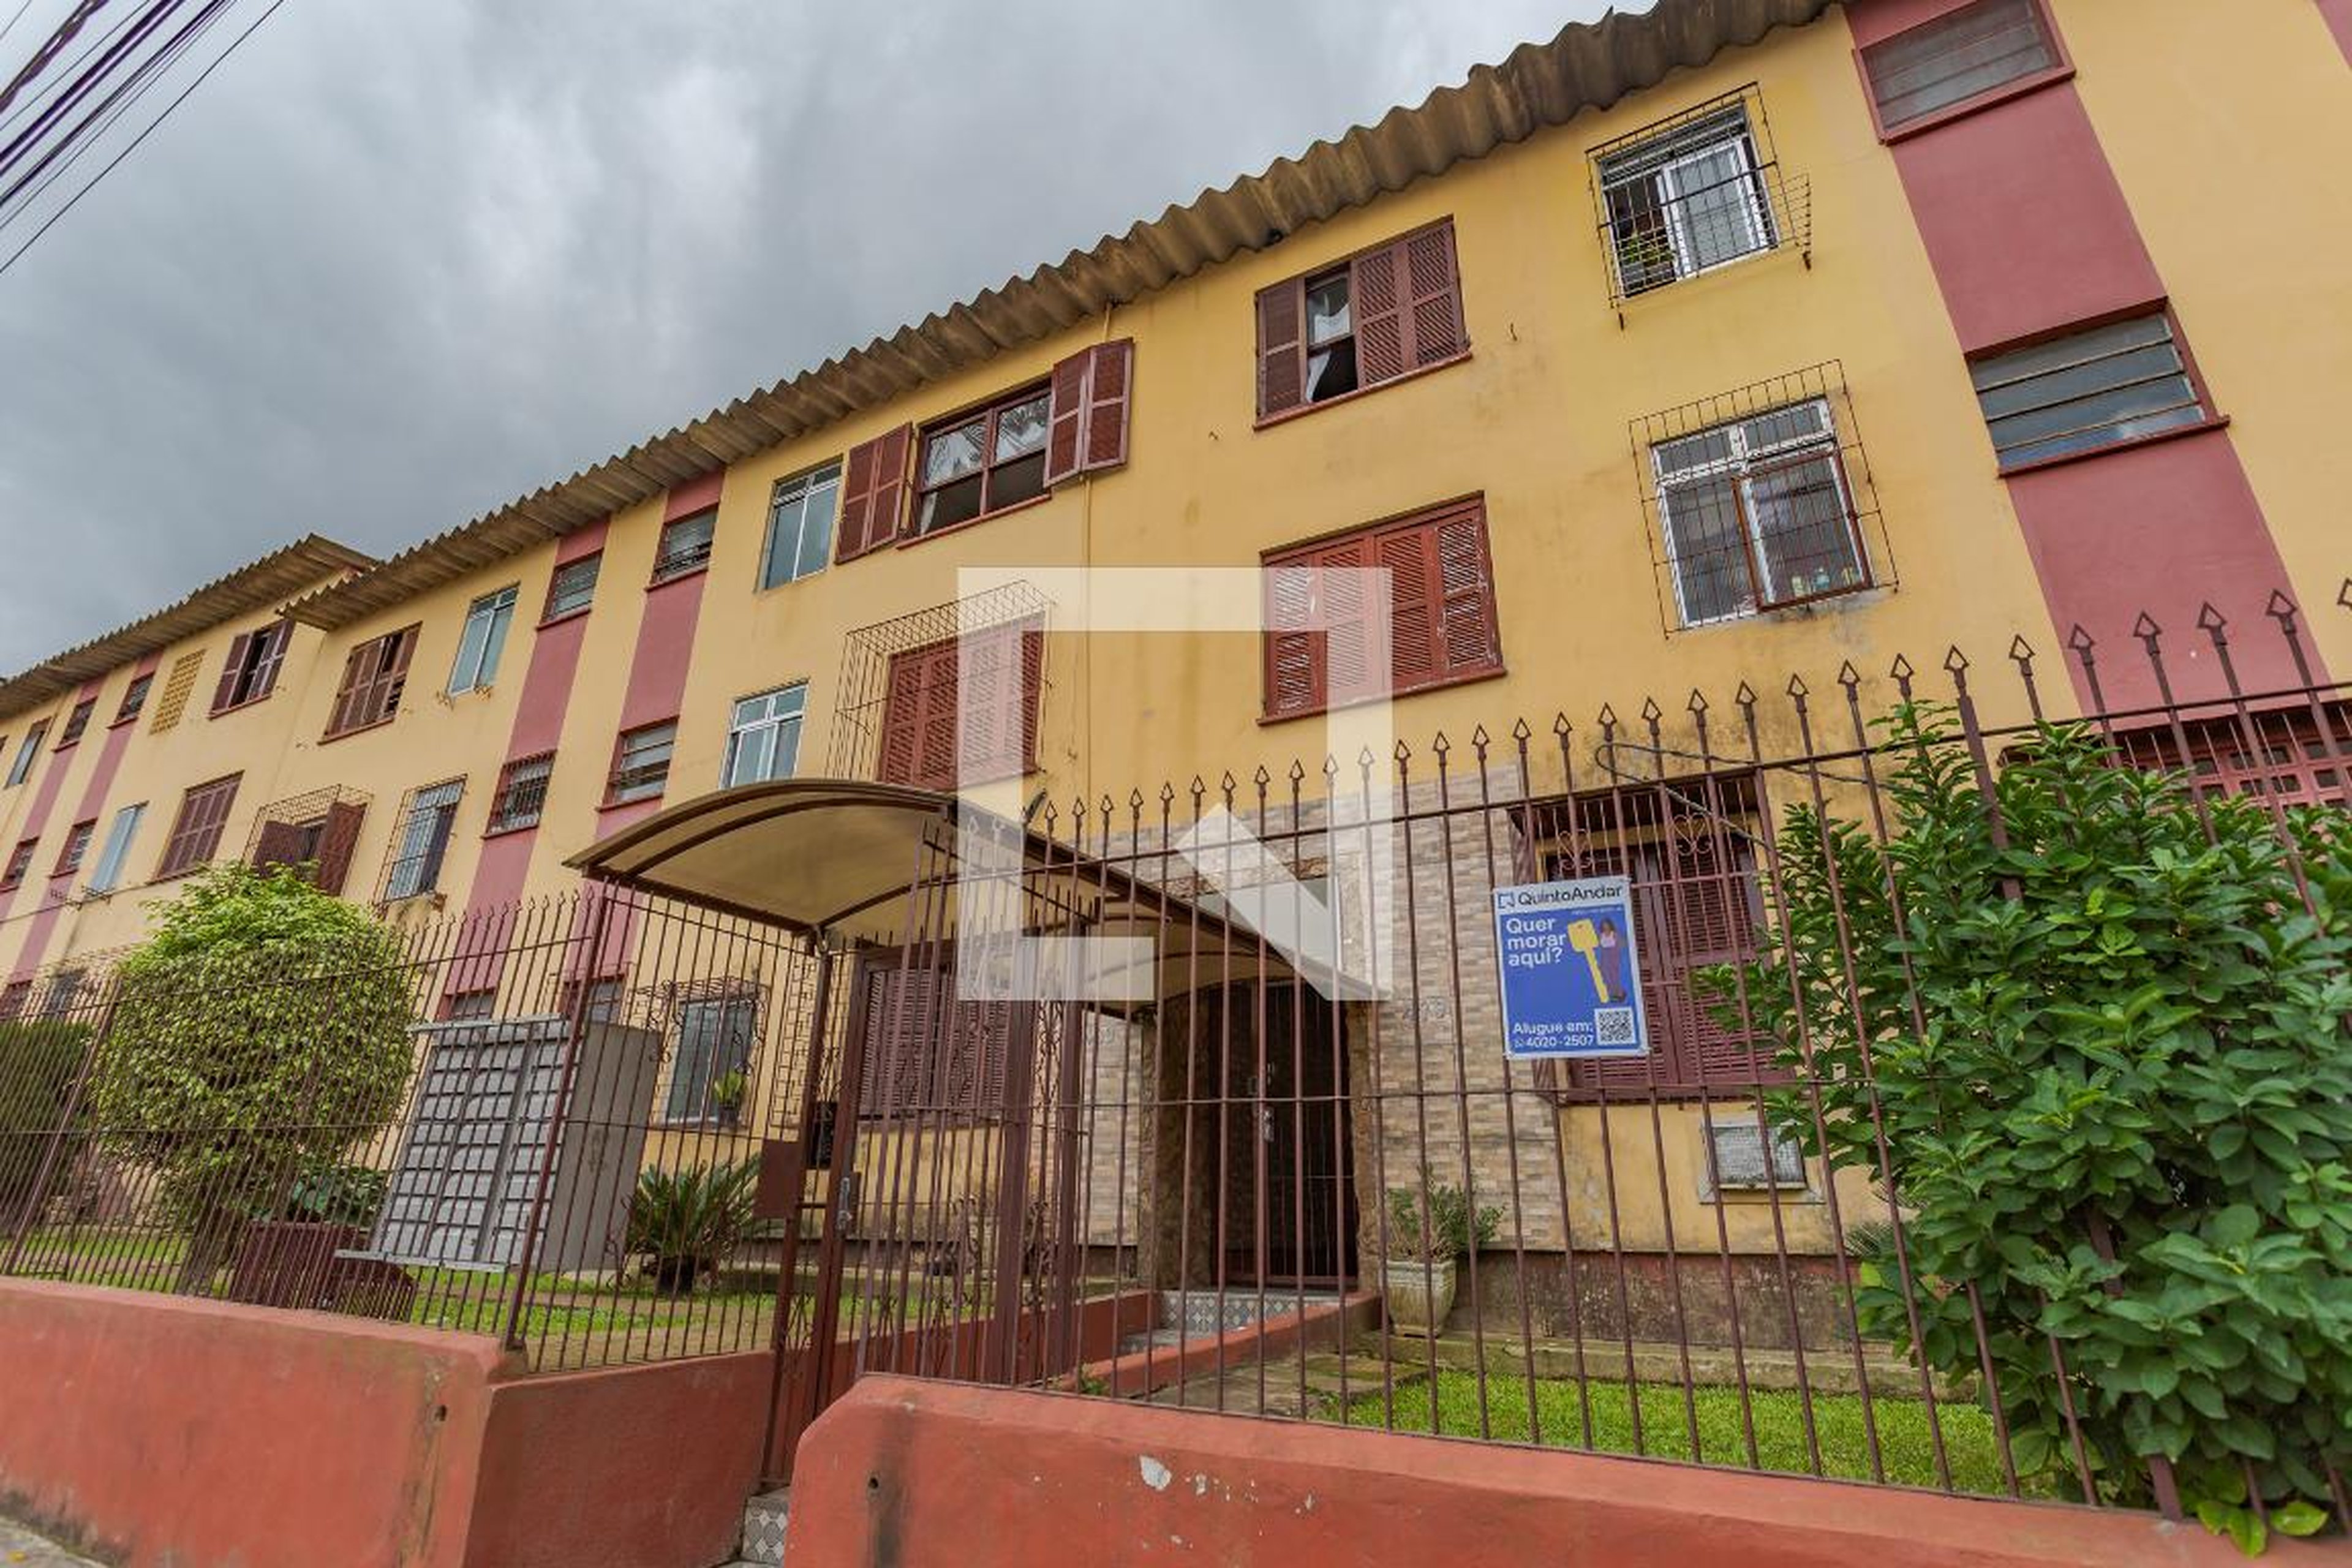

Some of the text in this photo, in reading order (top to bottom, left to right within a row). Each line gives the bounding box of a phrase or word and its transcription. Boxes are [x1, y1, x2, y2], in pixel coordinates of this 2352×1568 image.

[1518, 887, 1622, 905] QuintoAndar
[1506, 918, 1555, 934] Quer
[1507, 933, 1566, 950] morar
[1509, 947, 1562, 968] aqui?
[1513, 1022, 1593, 1035] Alugue em:
